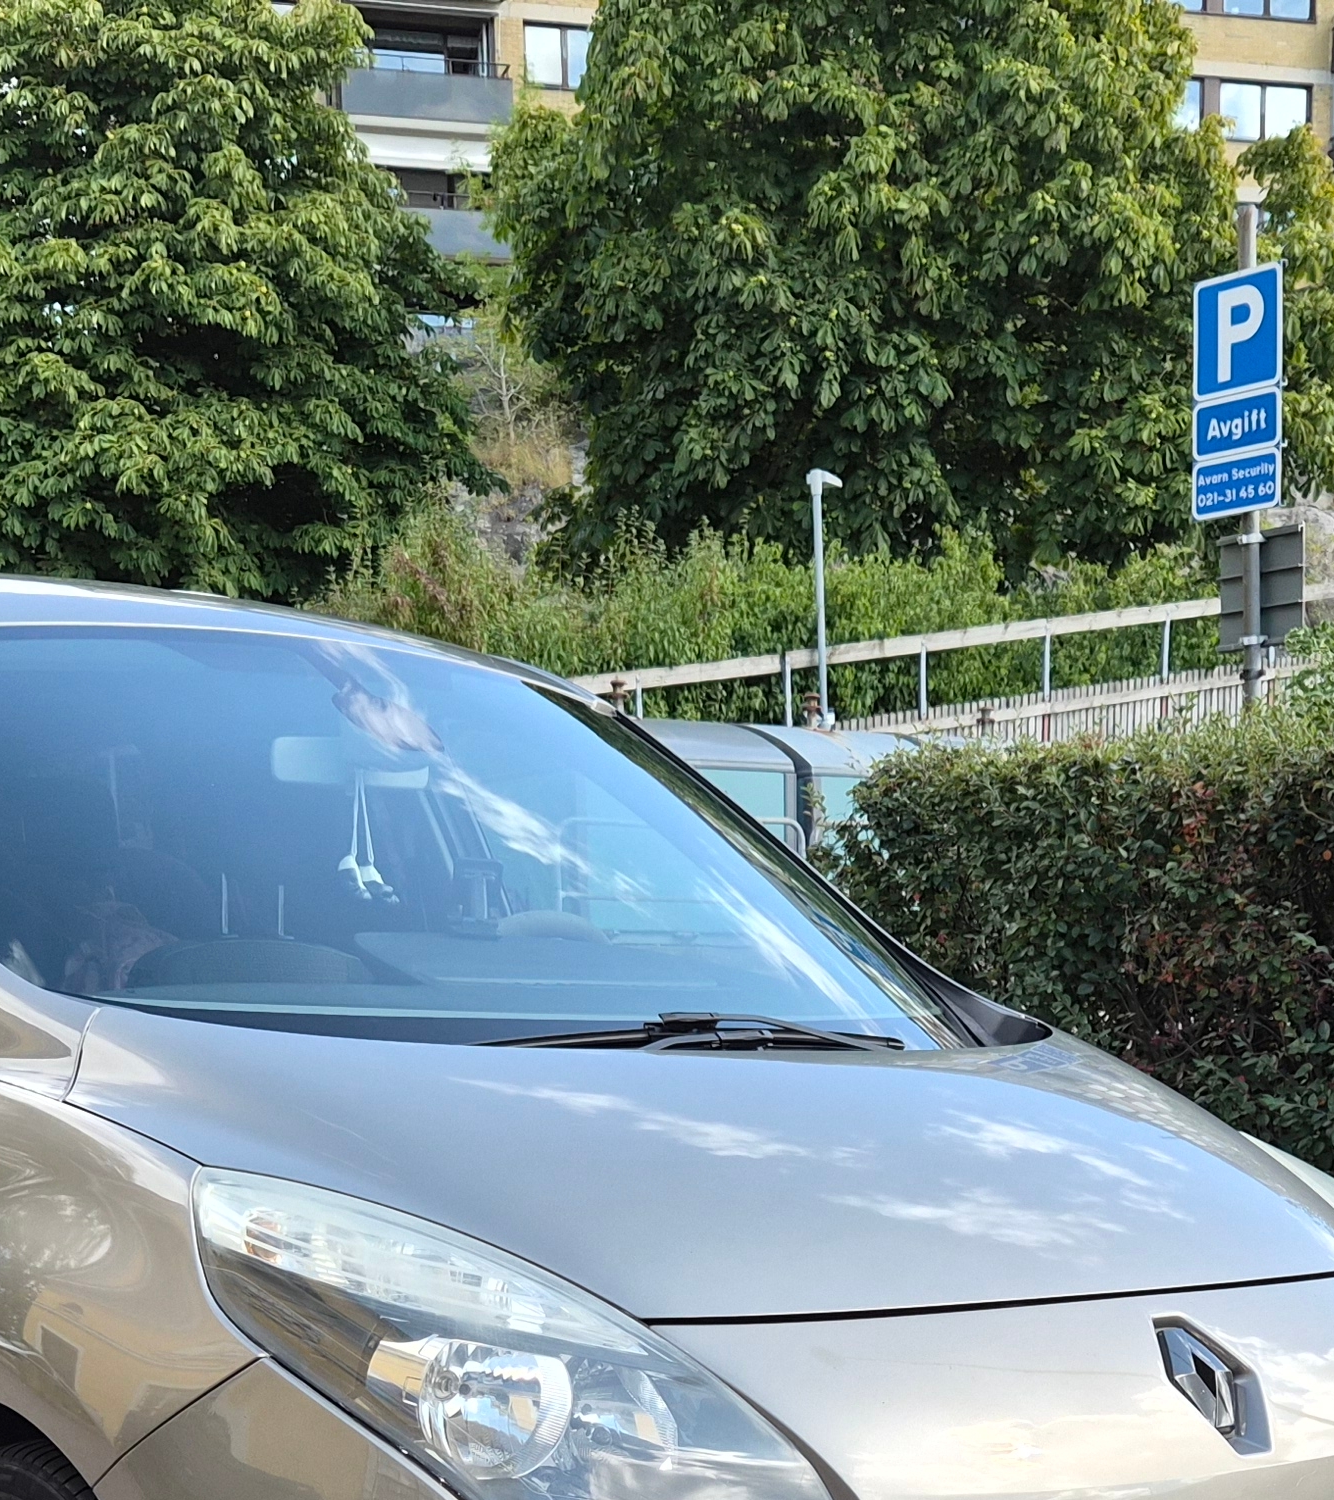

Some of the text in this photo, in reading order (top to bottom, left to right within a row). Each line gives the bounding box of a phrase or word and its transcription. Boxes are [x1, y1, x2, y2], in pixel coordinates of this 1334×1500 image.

[1218, 284, 1264, 384] P
[1207, 407, 1267, 441] Avgift
[1198, 461, 1275, 487] Avarn Security
[1197, 481, 1275, 507] 021-31 45 60
